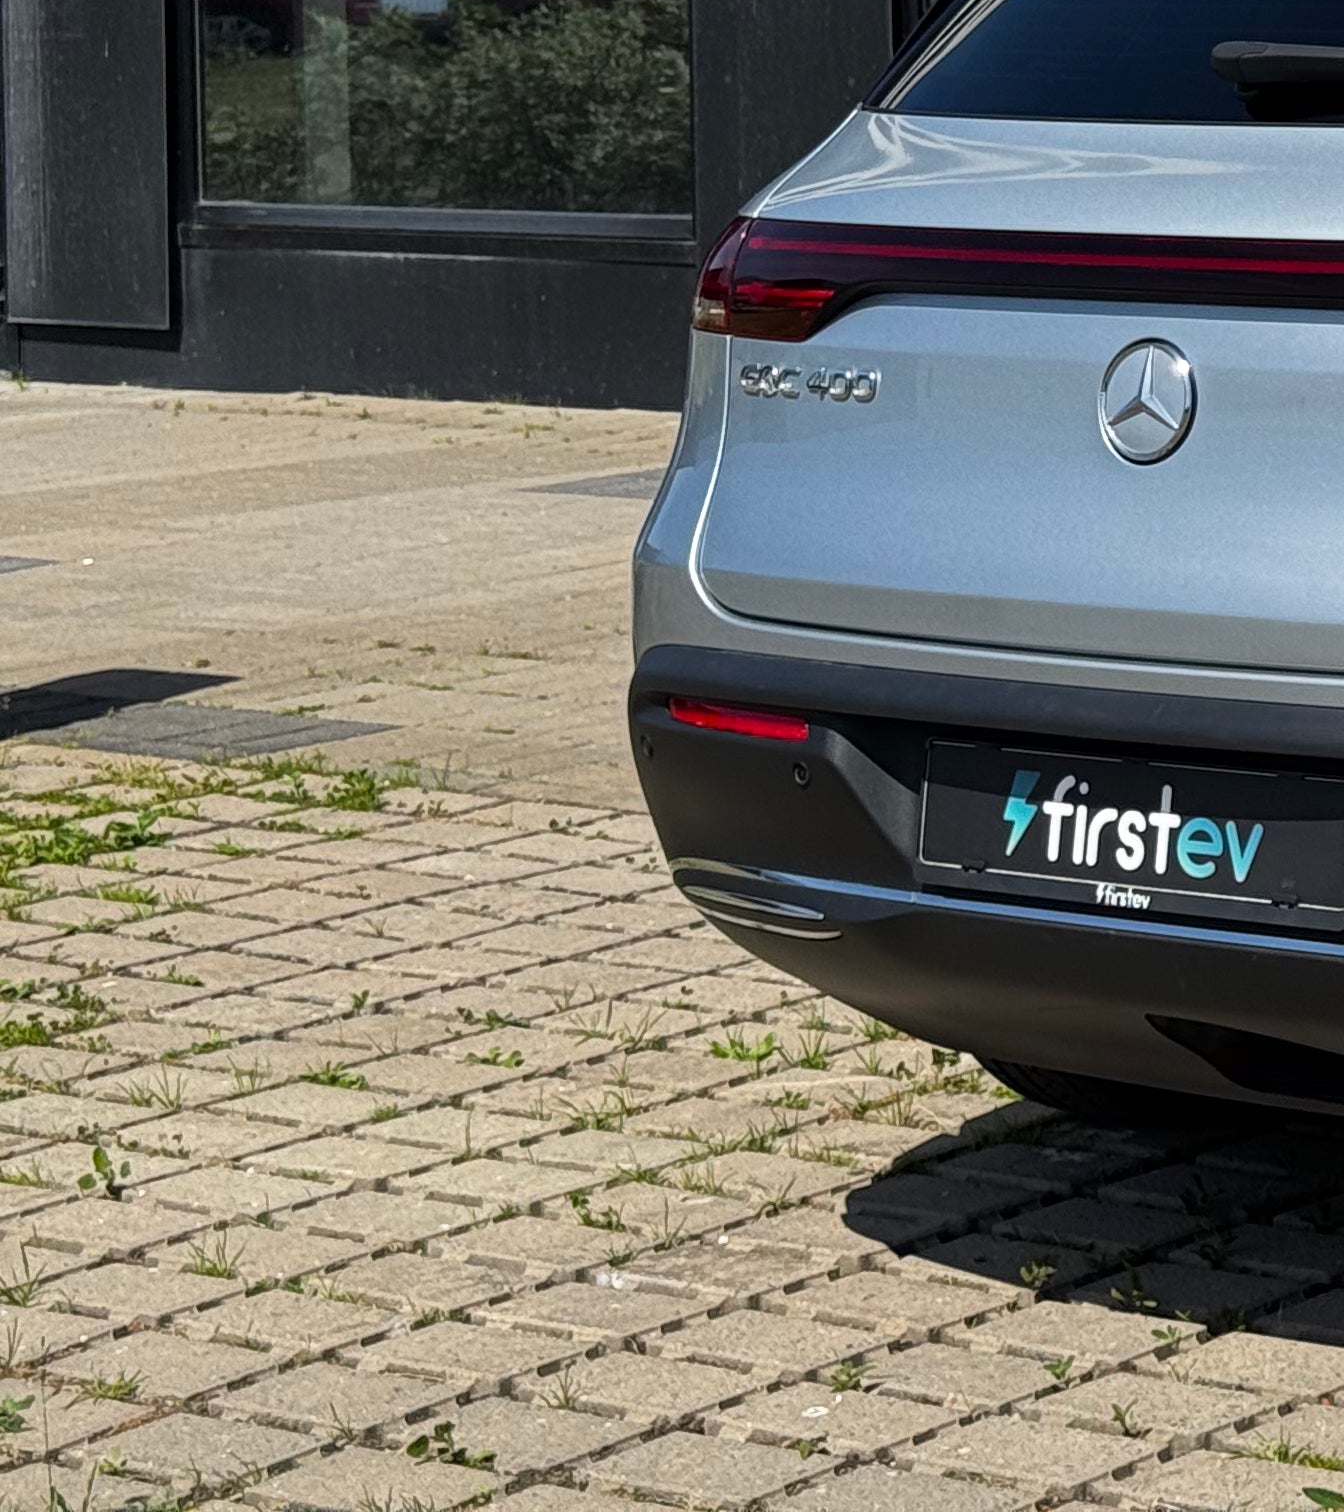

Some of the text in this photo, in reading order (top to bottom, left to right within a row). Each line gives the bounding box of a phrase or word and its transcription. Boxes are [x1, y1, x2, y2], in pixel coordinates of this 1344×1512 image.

[806, 367, 881, 403] 400
[1042, 775, 1264, 883] firstev
[1104, 884, 1151, 909] firstev
